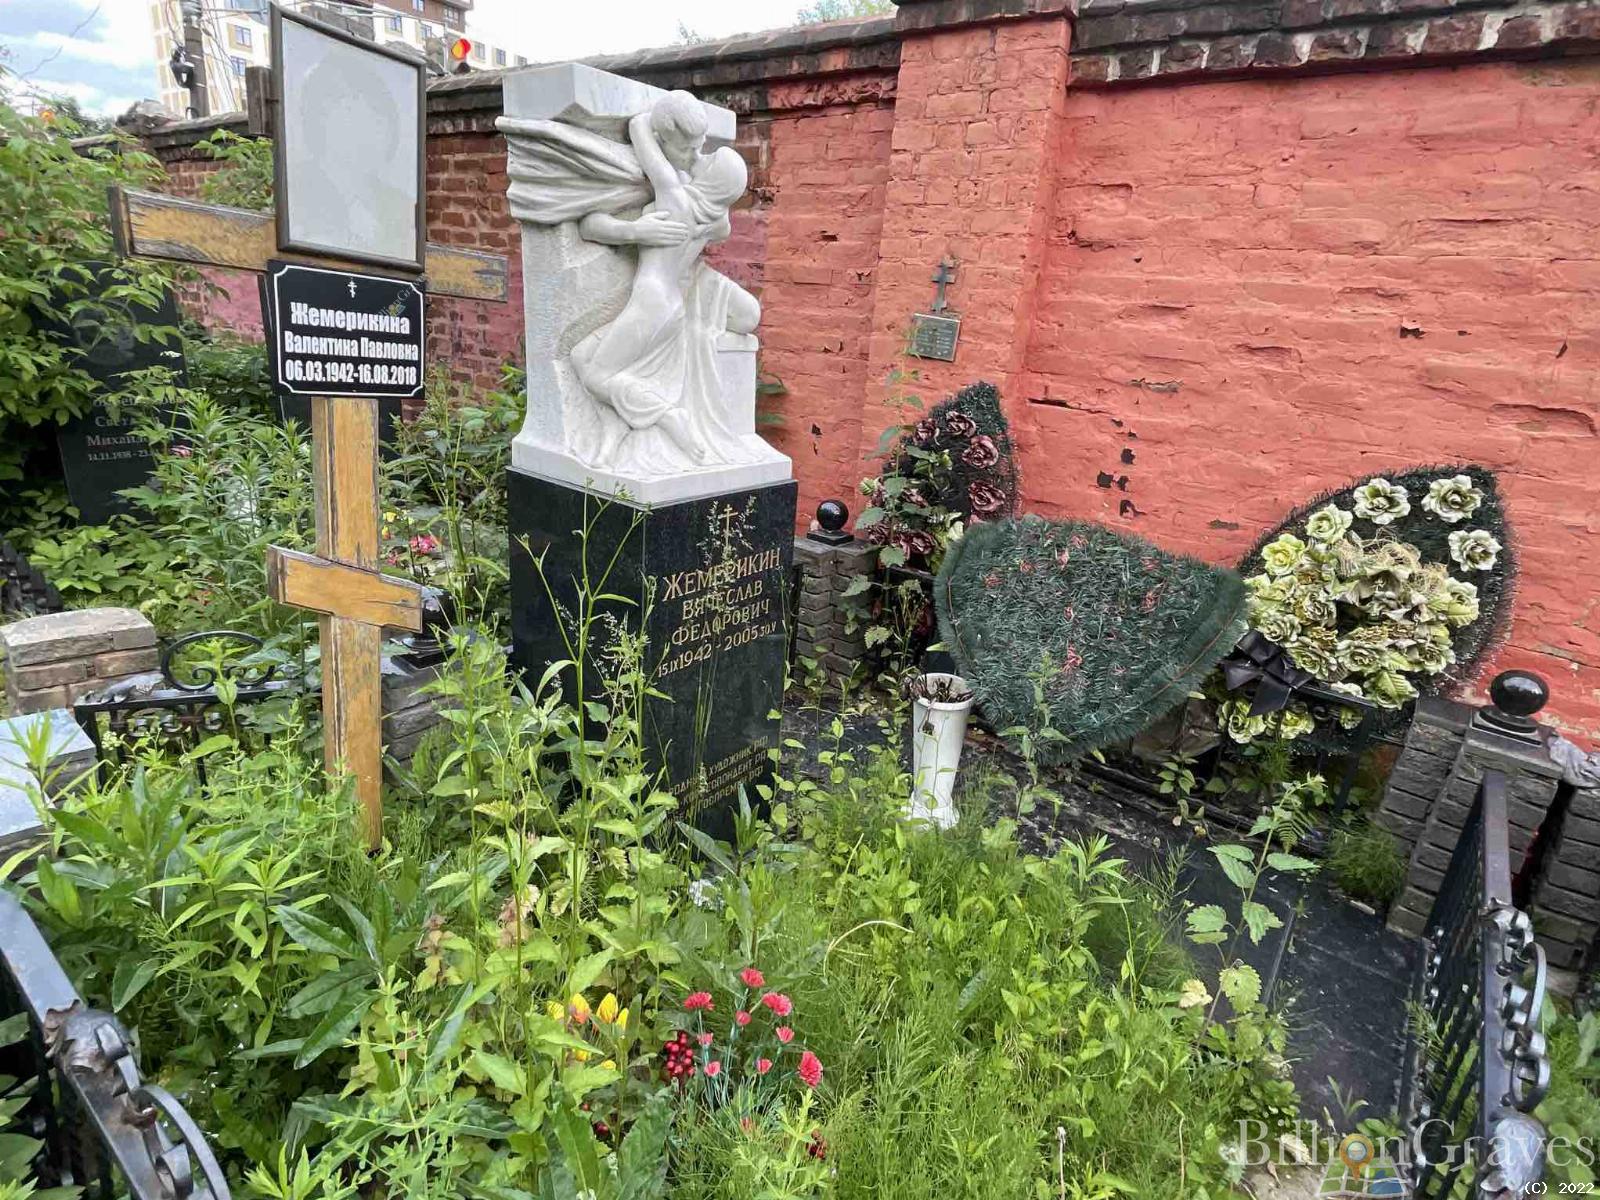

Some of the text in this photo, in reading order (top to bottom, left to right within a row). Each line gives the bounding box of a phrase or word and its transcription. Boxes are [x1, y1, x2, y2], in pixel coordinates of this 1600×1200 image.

[290, 302, 410, 334] Жемерикина
[284, 331, 419, 361] Валентина Павловна
[662, 549, 780, 602] ЖЕМЕРИКИН
